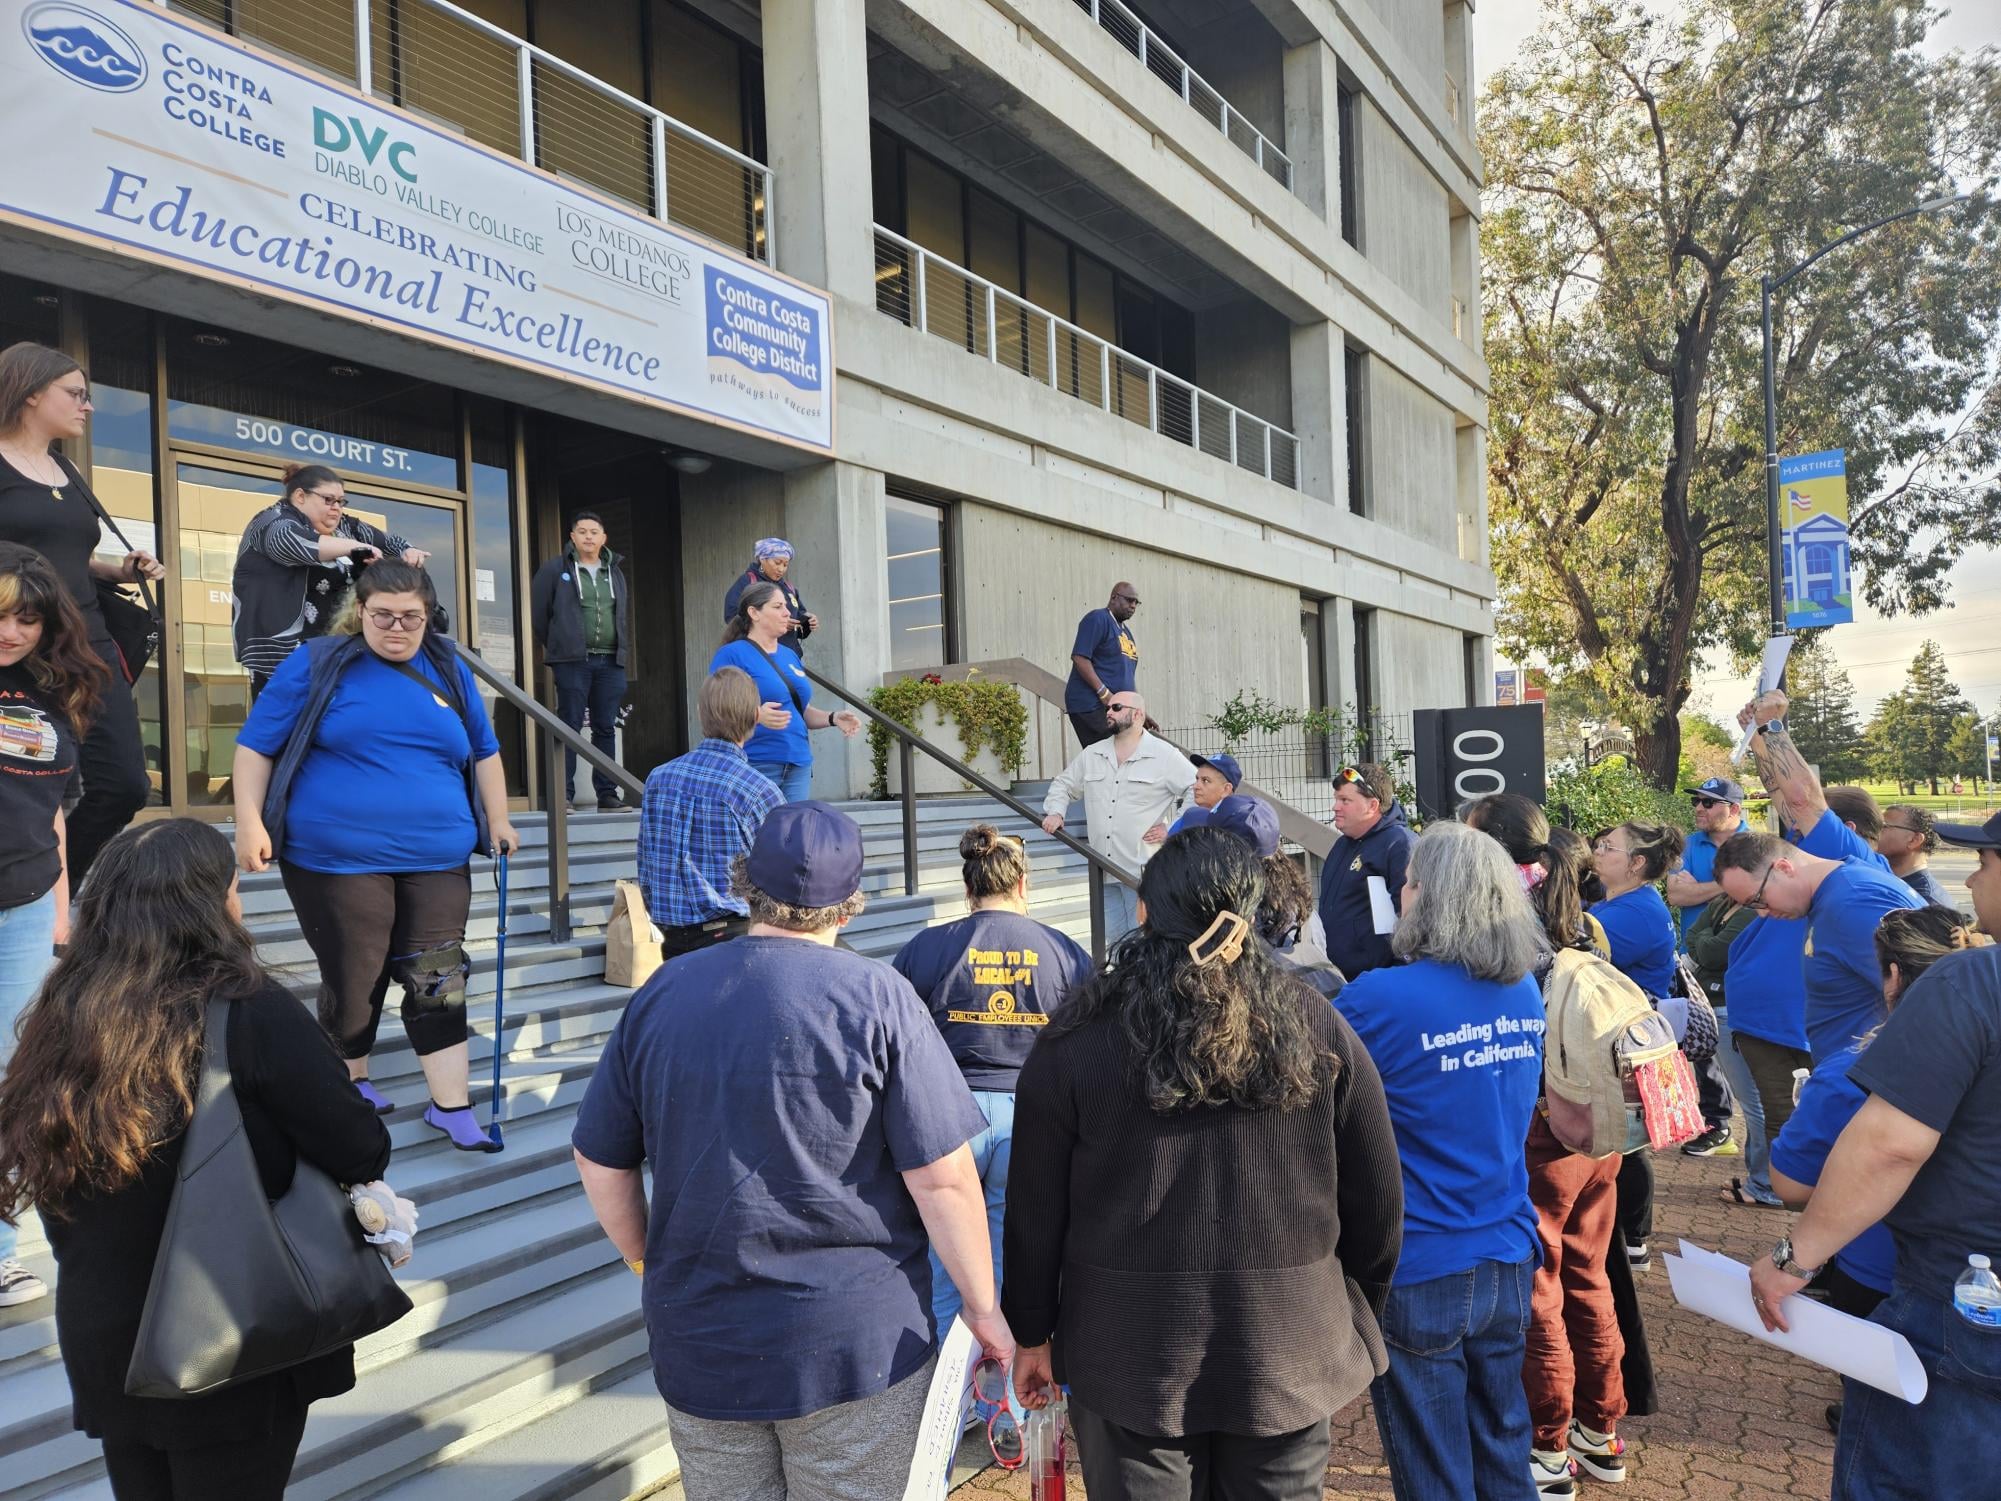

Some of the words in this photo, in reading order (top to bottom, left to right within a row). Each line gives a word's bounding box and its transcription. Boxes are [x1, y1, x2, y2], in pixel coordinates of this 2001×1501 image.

[162, 43, 273, 104] CONTRA
[162, 69, 253, 121] COSTA
[163, 95, 285, 158] COLLEGE
[312, 105, 418, 183] DVC
[315, 152, 388, 196] DIABLO
[395, 182, 461, 223] VALLEY
[468, 212, 545, 255] COLLEGE
[300, 192, 537, 293] CELEBRATING
[557, 207, 592, 239] LOS
[598, 223, 690, 280] MEDANOS
[571, 240, 681, 301] COLLEGE
[95, 166, 440, 314] Educational
[456, 283, 660, 381] Excellence
[715, 277, 767, 316] Contra
[771, 300, 811, 334] Costa
[724, 305, 807, 361] Community
[713, 327, 767, 366] College
[770, 347, 817, 382] District
[710, 373, 764, 400] pathways
[784, 396, 821, 417] success
[236, 418, 283, 446] 500
[291, 430, 375, 464] COURT
[382, 447, 412, 471] ST.
[1783, 459, 1841, 475] MARTINEZ
[949, 1012, 977, 1021] PUBLIC
[979, 1014, 1022, 1023] EMPLOYEES
[1421, 1023, 1493, 1051] Leading
[1495, 1015, 1520, 1035] the
[1520, 1018, 1546, 1036] way
[1440, 1054, 1459, 1072] in
[1463, 1040, 1535, 1068] California
